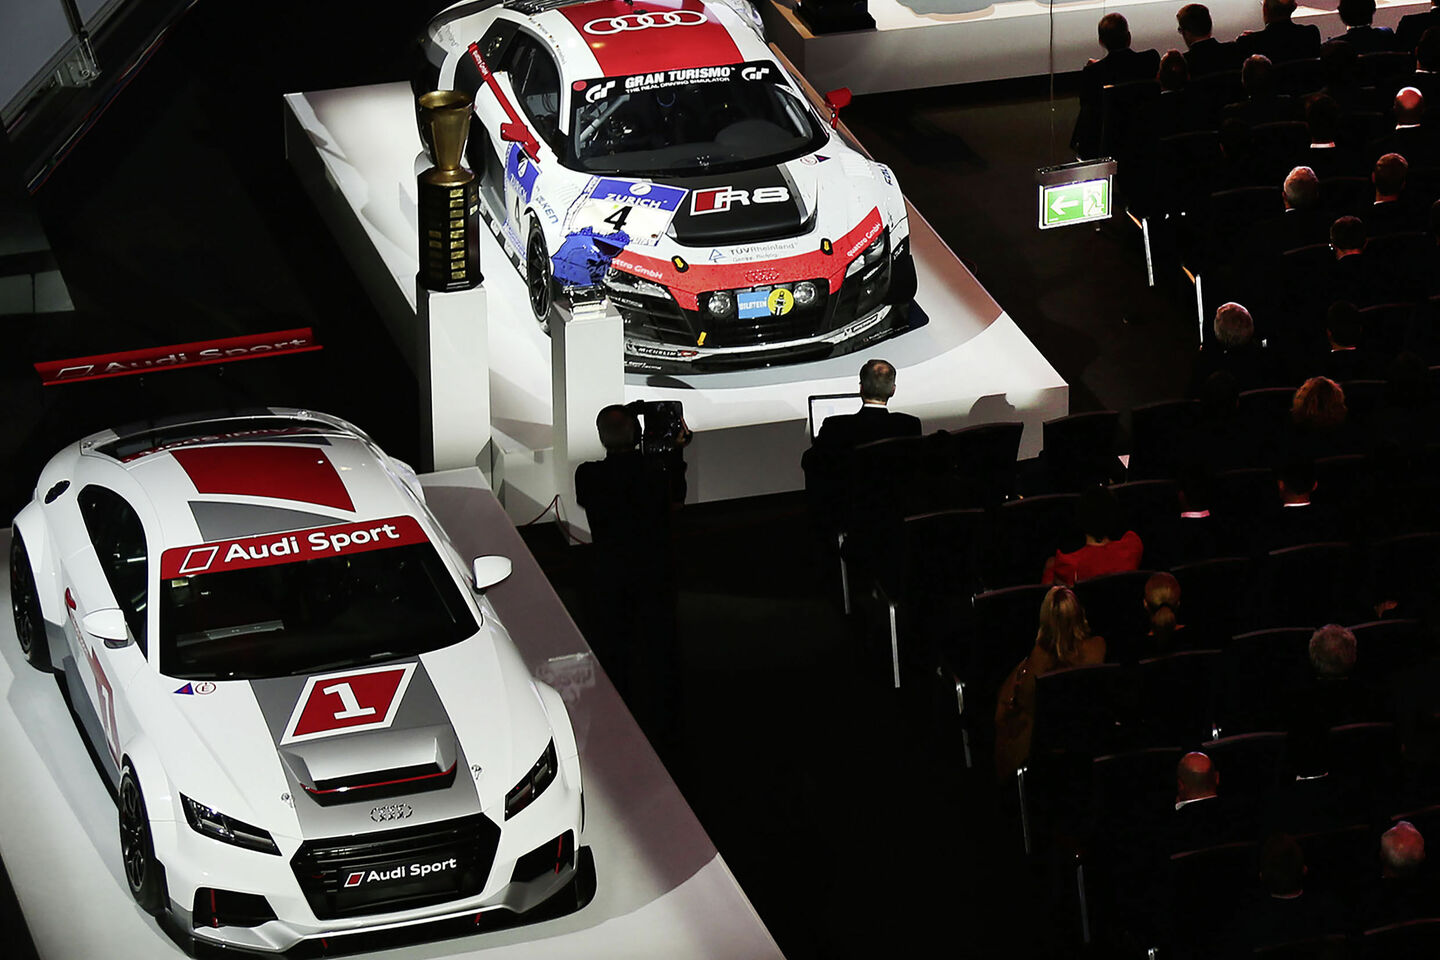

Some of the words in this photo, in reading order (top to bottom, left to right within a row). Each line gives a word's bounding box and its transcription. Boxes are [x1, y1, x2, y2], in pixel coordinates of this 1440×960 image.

[625, 72, 664, 88] GRAN
[668, 67, 730, 81] TURISMO
[606, 193, 662, 209] ZURICH
[714, 186, 789, 209] R8
[604, 206, 633, 231] 4
[846, 237, 868, 257] quattro
[865, 222, 881, 240] GmbH
[634, 264, 663, 280] GmbH
[105, 352, 186, 372] Audi
[200, 339, 306, 361] Sport
[224, 536, 299, 562] Audi
[307, 523, 400, 551] Sport
[323, 682, 376, 720] 1
[367, 866, 405, 882] Audi
[410, 858, 457, 877] Sport
